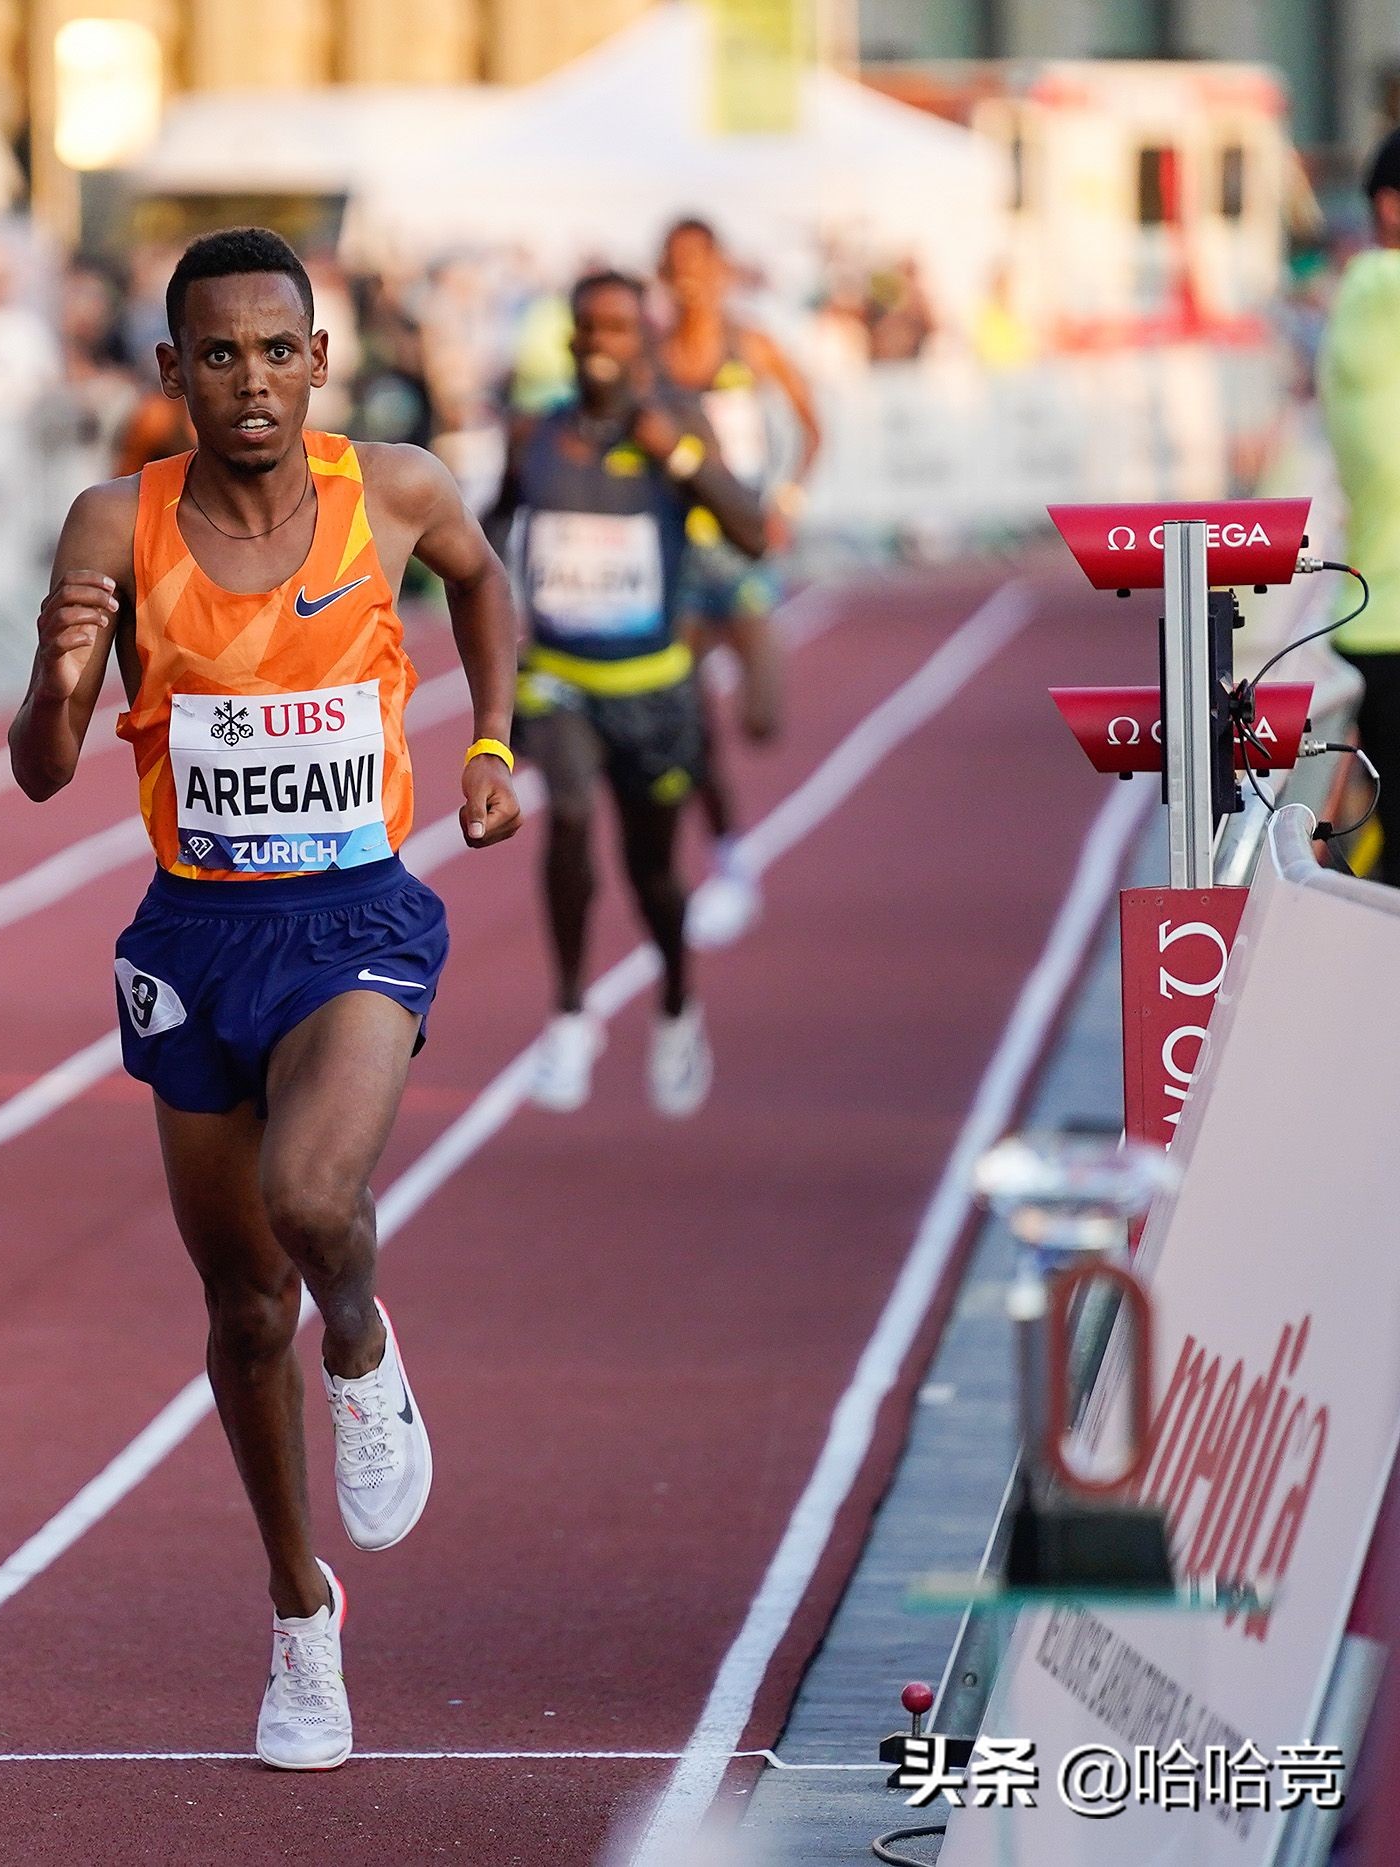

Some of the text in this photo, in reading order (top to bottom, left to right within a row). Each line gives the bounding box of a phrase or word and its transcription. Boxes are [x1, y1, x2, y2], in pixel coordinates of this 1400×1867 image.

[1149, 522, 1271, 550] OEGA
[260, 697, 346, 737] UBS
[185, 753, 375, 816] AREGAWI
[231, 839, 339, 865] ZURICH
[131, 974, 159, 1030] 9
